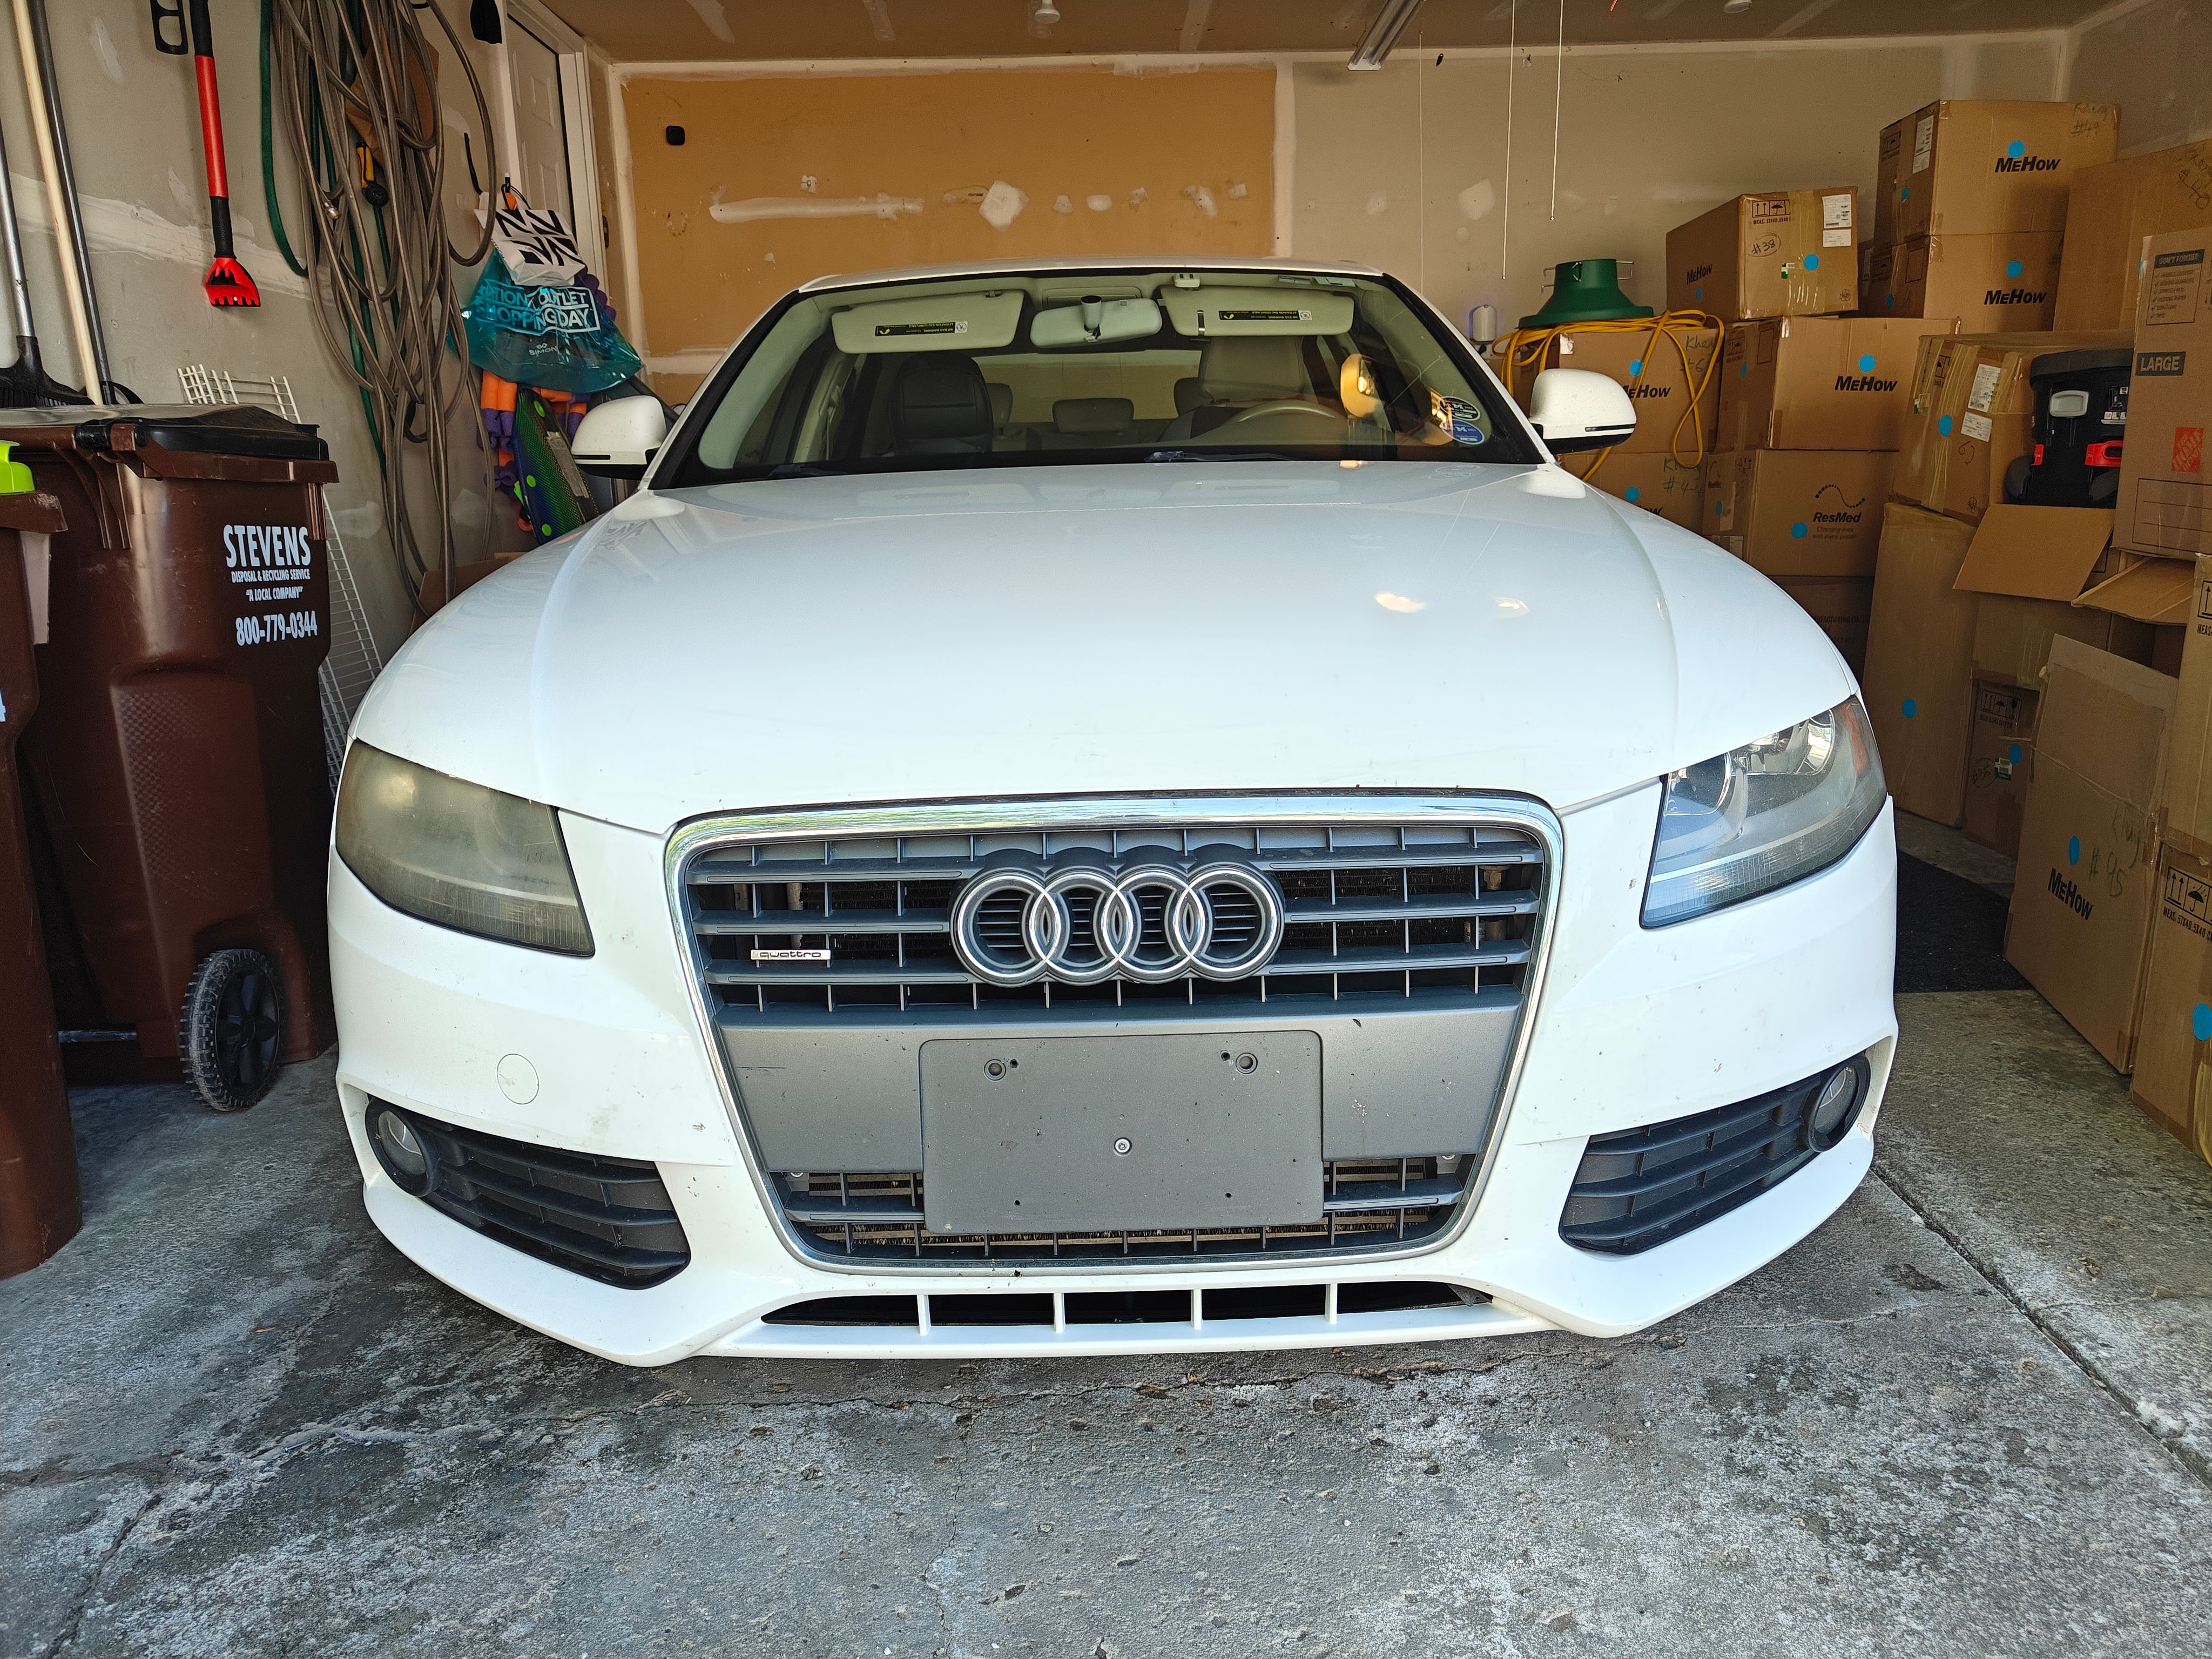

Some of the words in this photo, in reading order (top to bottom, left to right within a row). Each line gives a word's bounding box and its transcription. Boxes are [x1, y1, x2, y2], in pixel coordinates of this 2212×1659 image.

[538, 289, 586, 307] OUTLET
[476, 304, 557, 331] HOPPING
[556, 308, 589, 328] DAY
[529, 345, 557, 356] SIMON
[2140, 356, 2180, 372] LARGE
[1813, 512, 1862, 523] ResMed
[223, 524, 311, 568] STEVENS
[231, 570, 257, 583] DISPOSAL
[257, 570, 263, 582] &
[262, 569, 289, 582] RECYCLING
[290, 568, 311, 581] SERVICE
[254, 588, 272, 601] LOCAL
[235, 610, 318, 646] 800-779-0344
